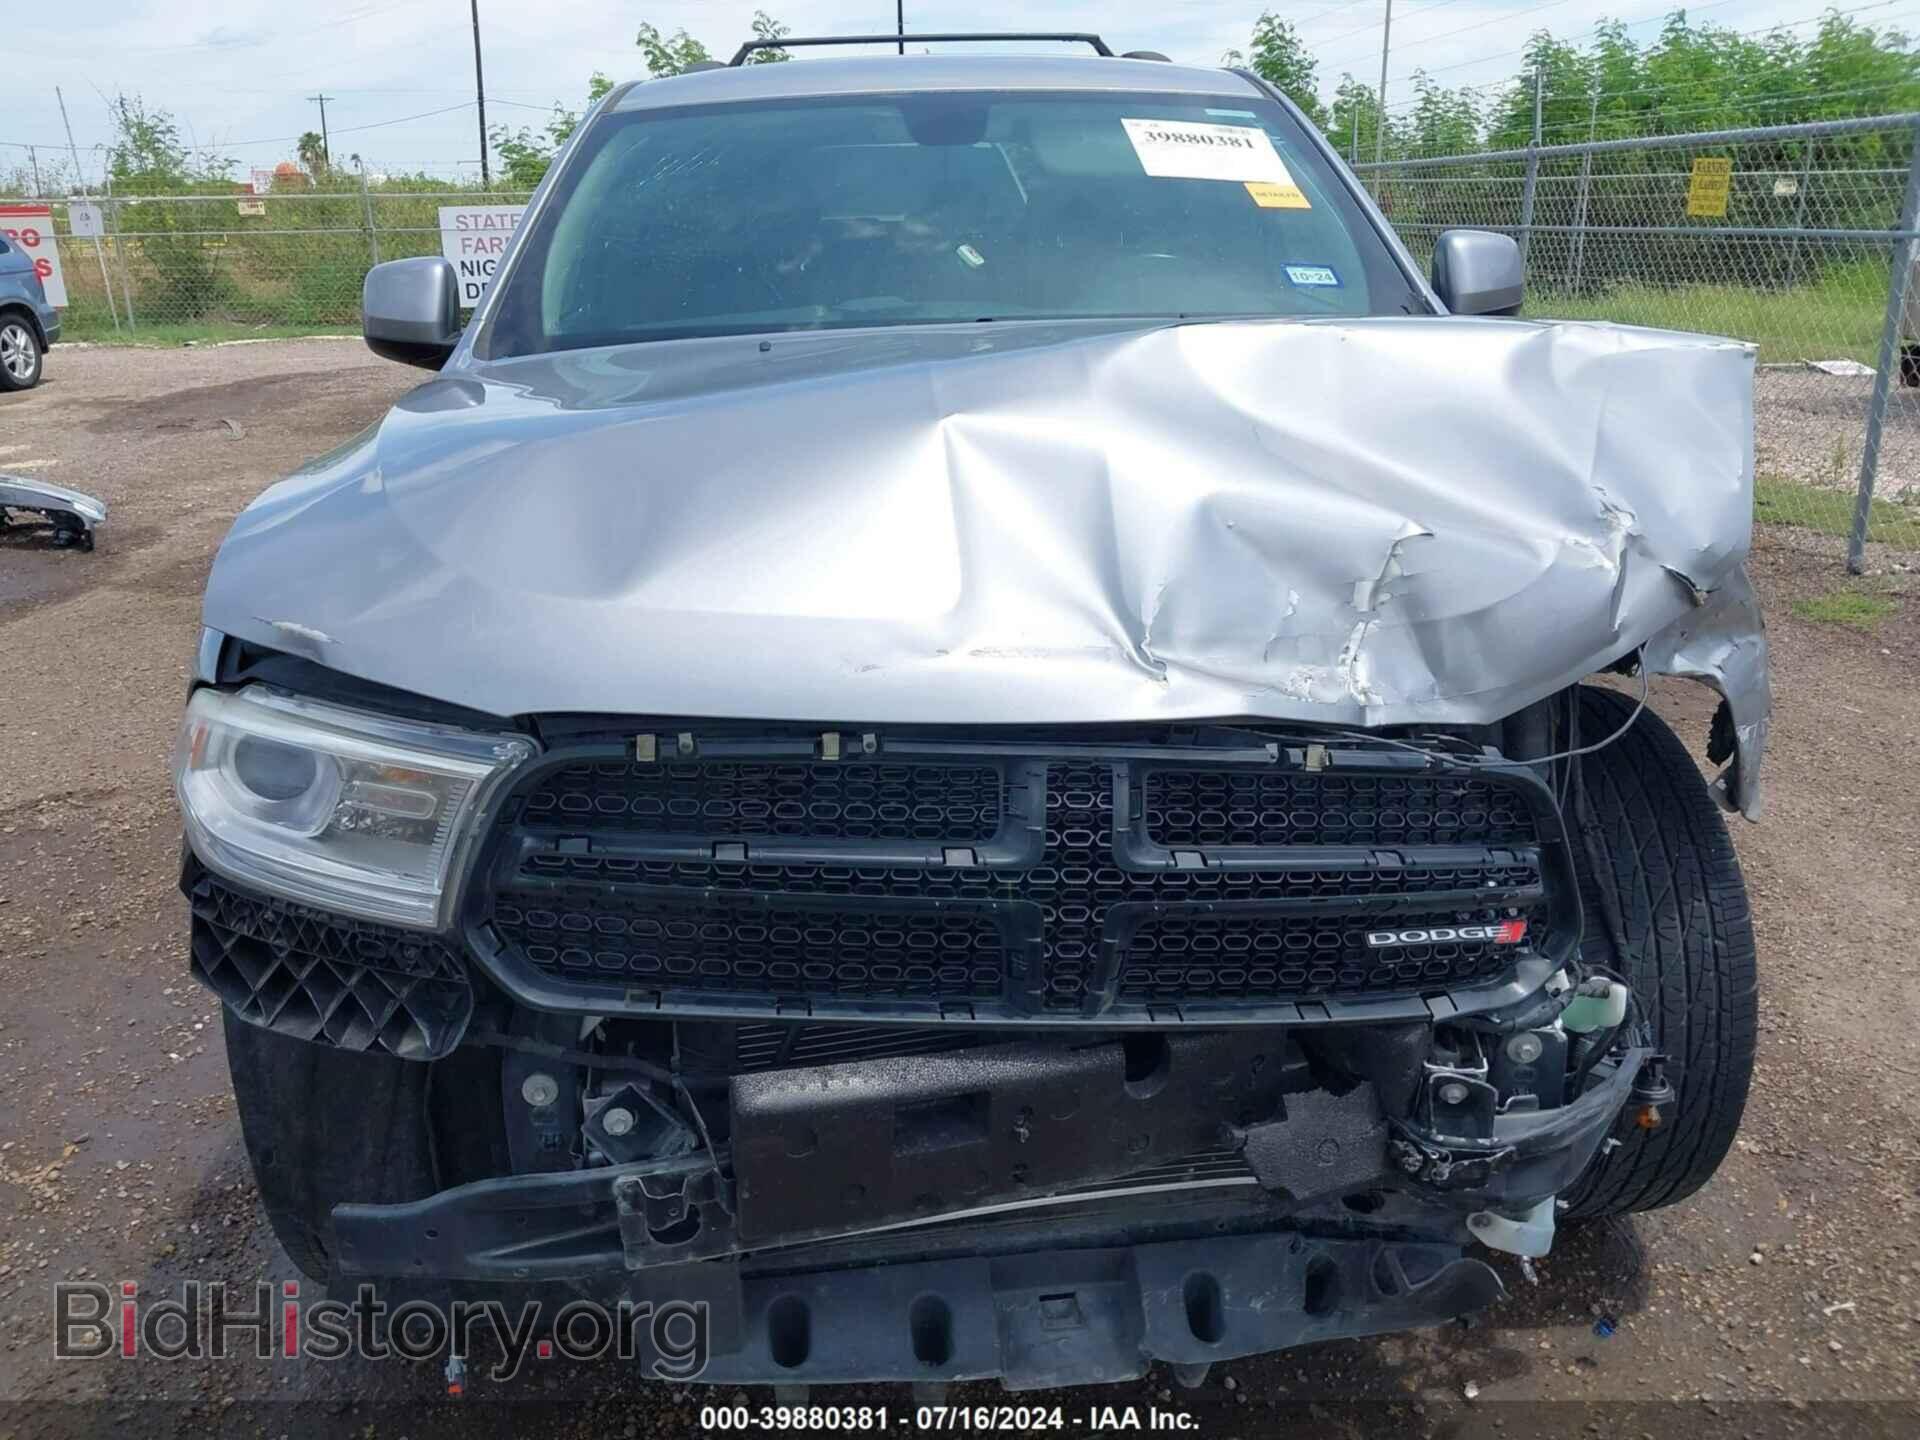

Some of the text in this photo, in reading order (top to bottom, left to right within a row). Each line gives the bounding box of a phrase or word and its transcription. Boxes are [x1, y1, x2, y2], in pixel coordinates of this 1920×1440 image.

[1144, 130, 1256, 150] 39880381
[460, 236, 512, 255] FAR
[1368, 925, 1511, 945] DODGE
